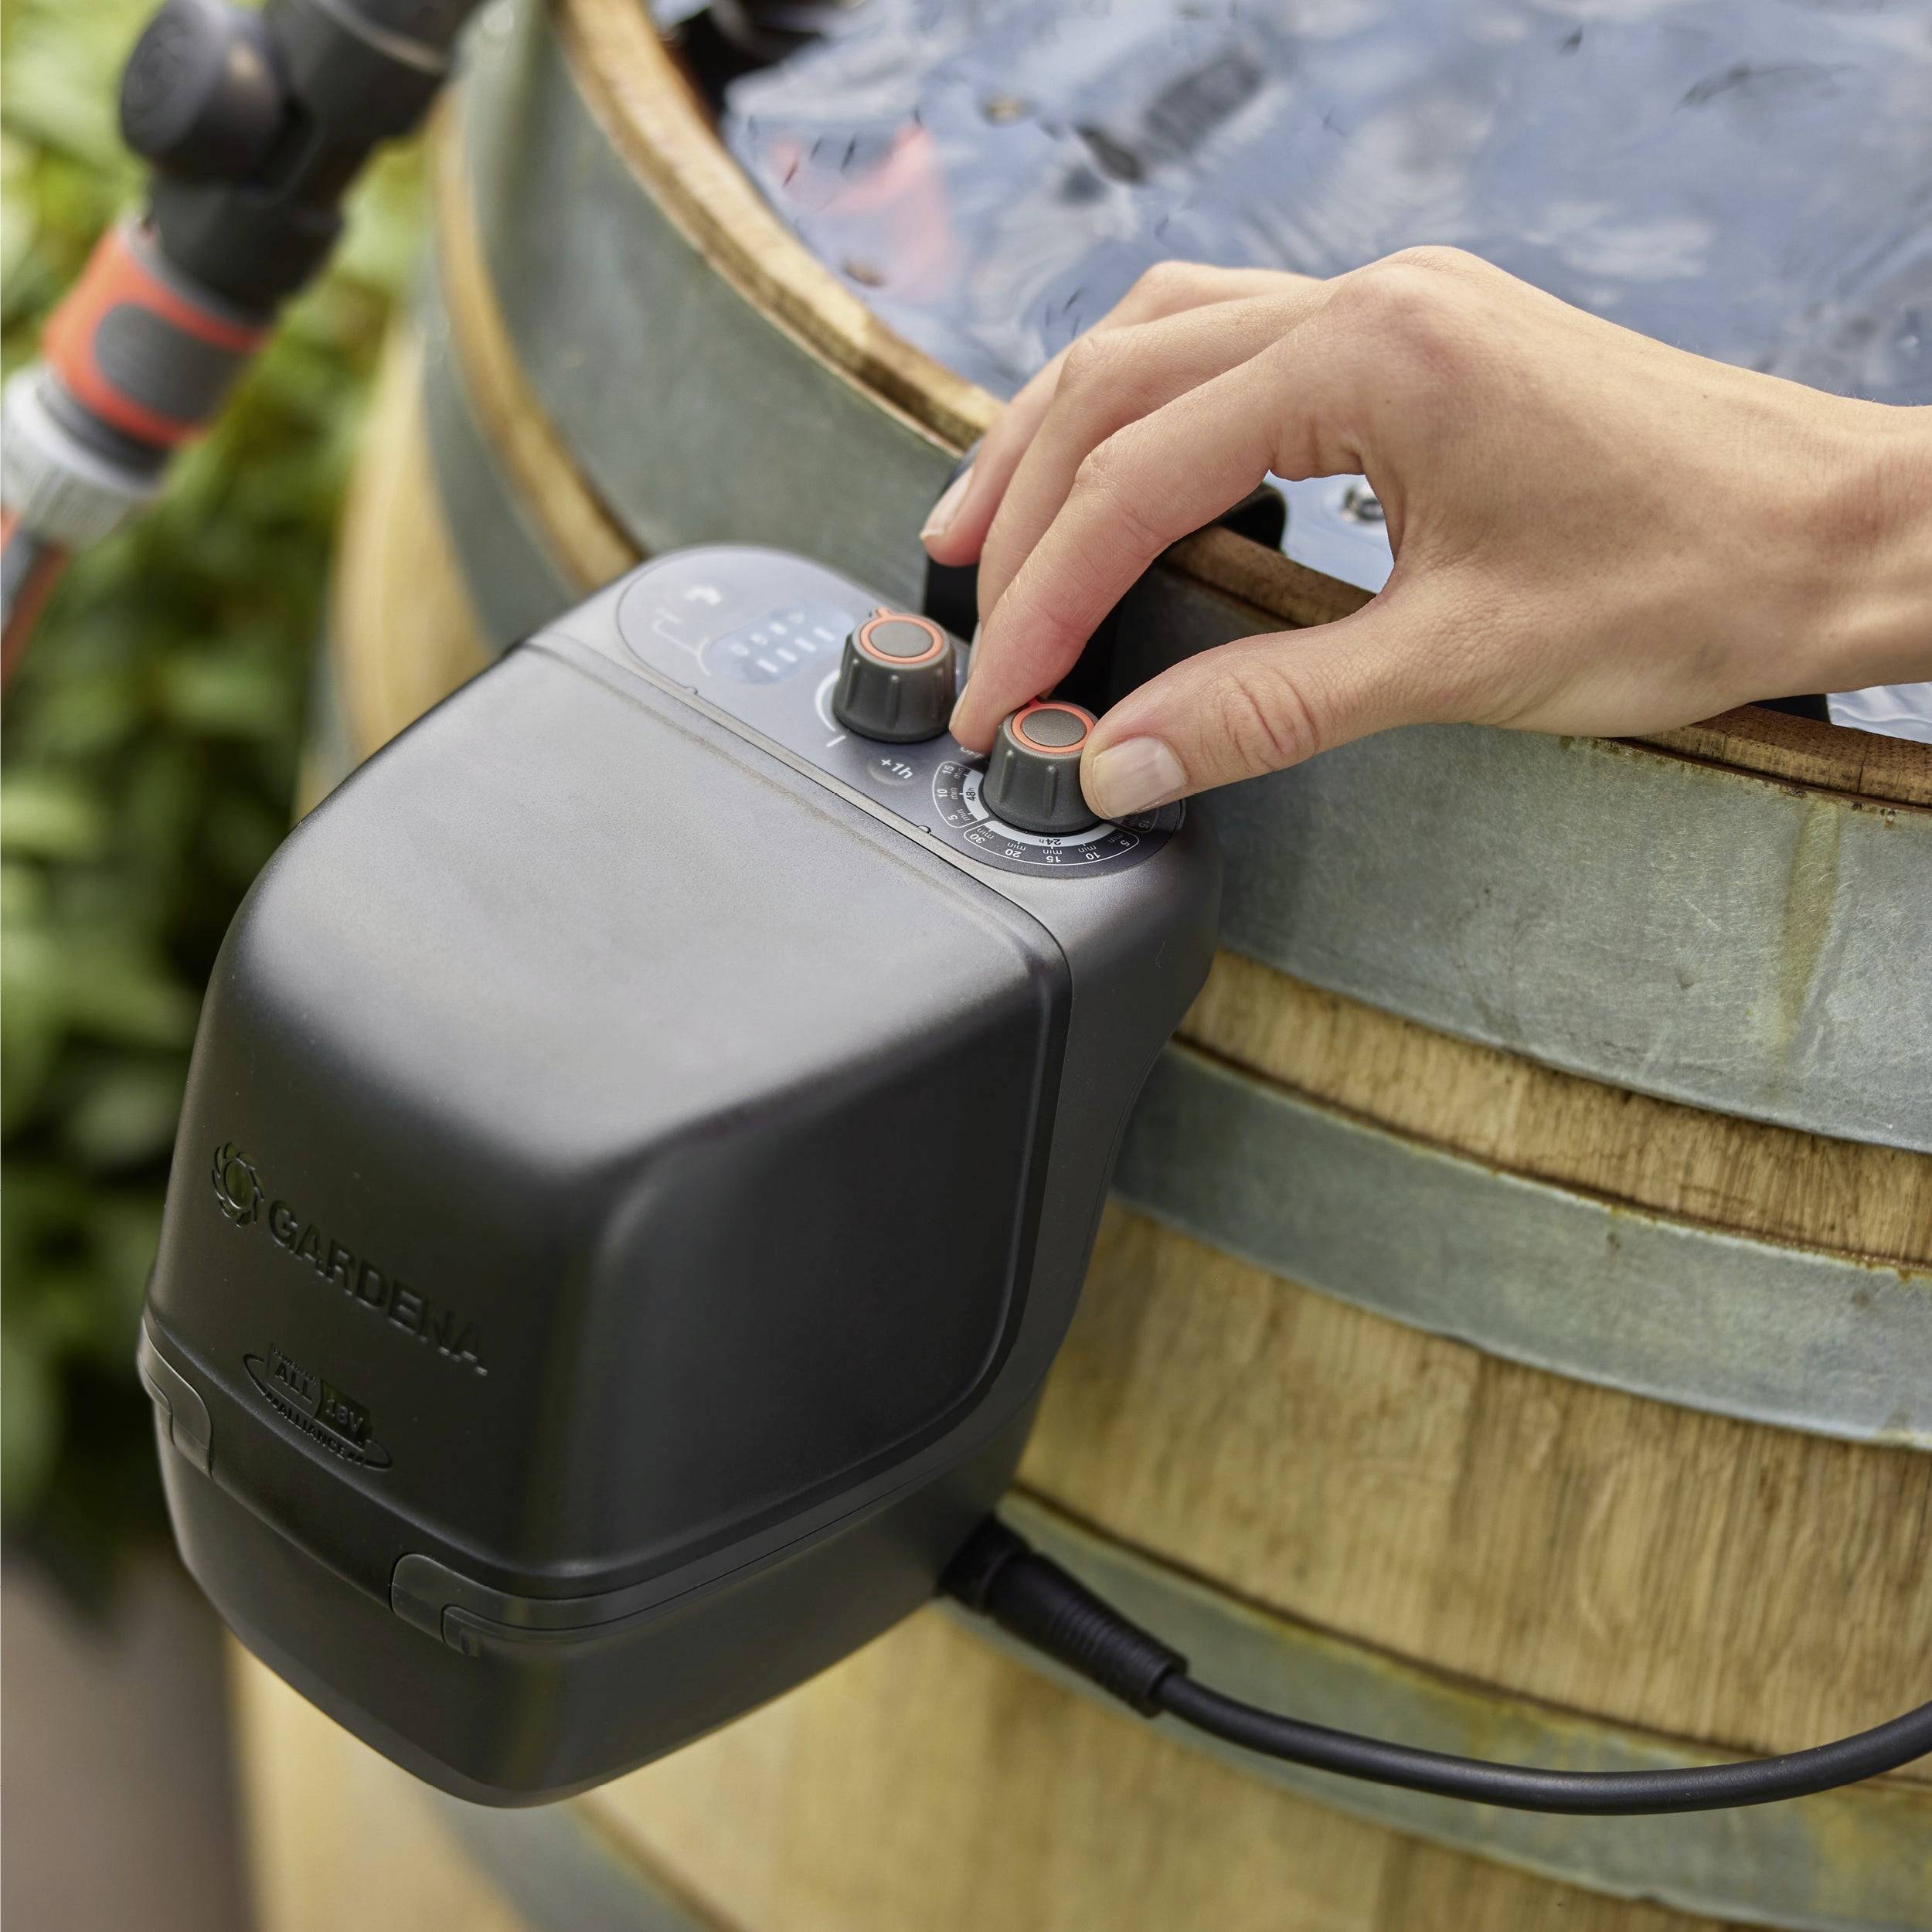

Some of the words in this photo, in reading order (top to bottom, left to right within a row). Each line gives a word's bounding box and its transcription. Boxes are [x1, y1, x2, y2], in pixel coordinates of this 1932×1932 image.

[881, 759, 913, 778] +1h
[937, 788, 947, 798] 10
[966, 787, 976, 801] 48h
[970, 833, 986, 844] 30
[976, 828, 995, 839] min
[1007, 842, 1026, 851] min
[1077, 845, 1097, 853] min
[1005, 849, 1022, 858] 20
[1085, 852, 1100, 860] 10
[269, 1199, 488, 1376] GARDENA
[275, 1362, 313, 1403] ALL
